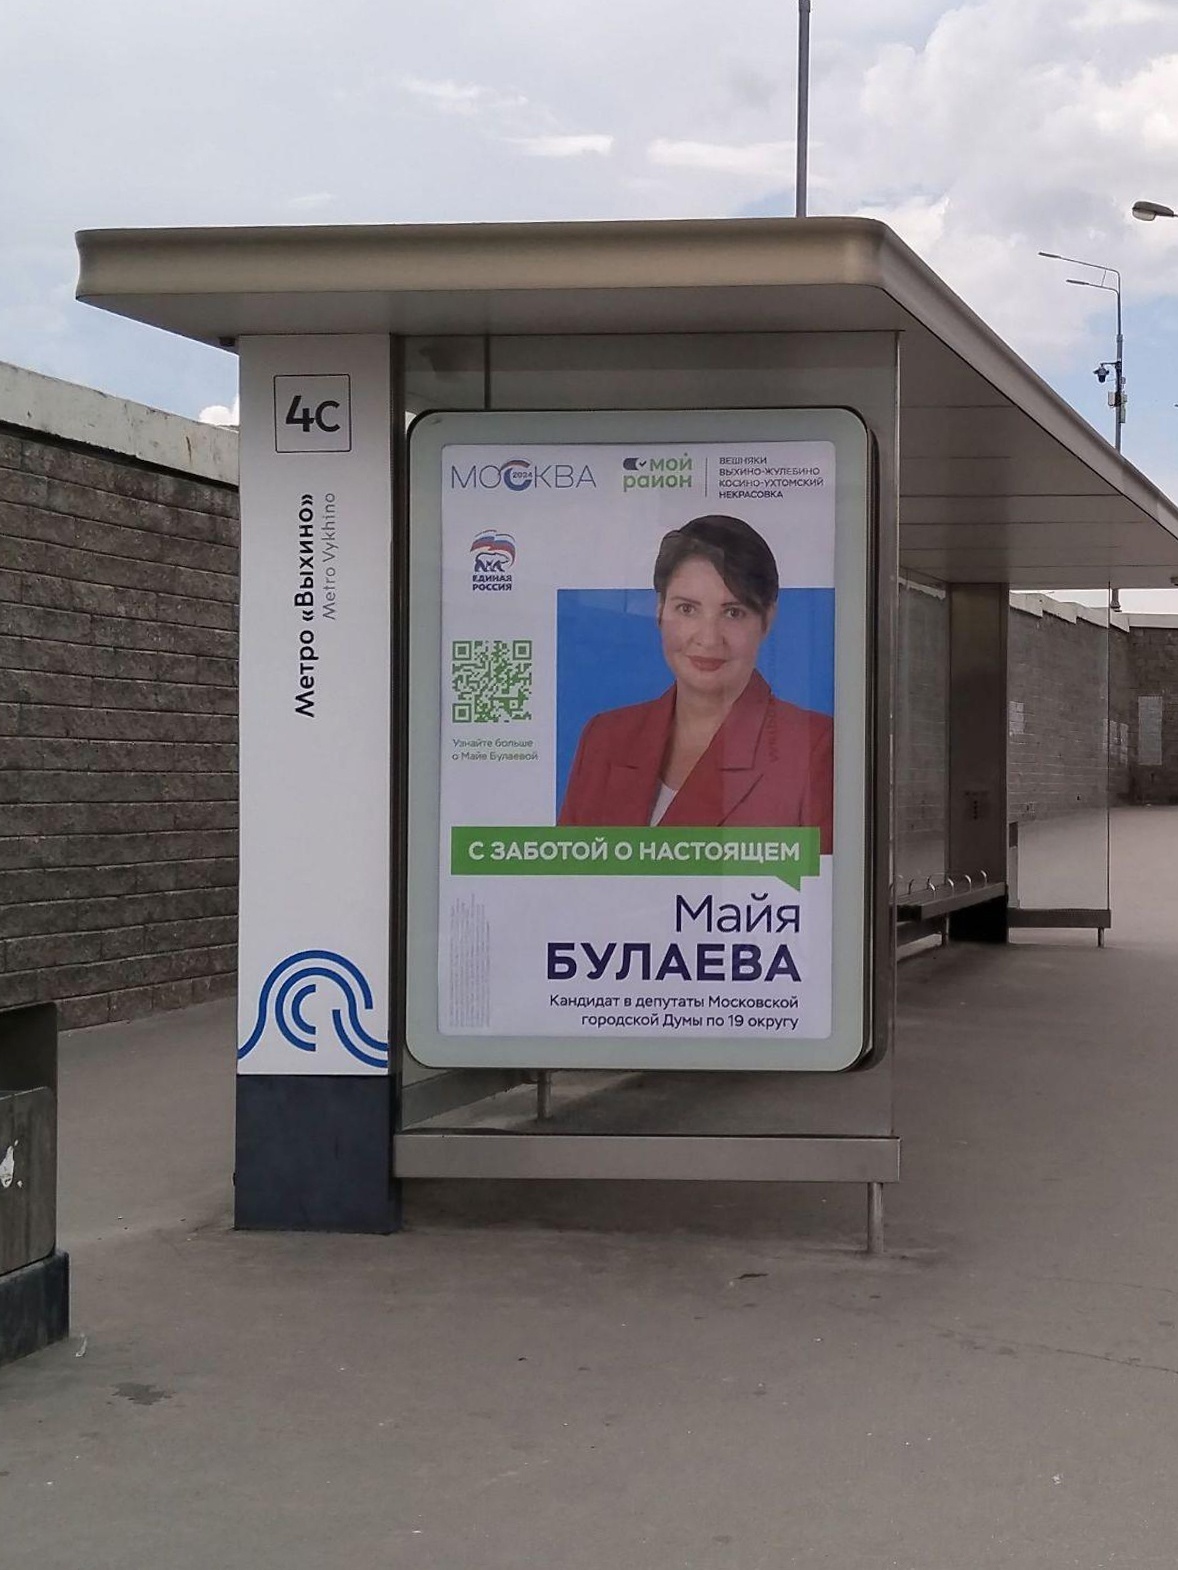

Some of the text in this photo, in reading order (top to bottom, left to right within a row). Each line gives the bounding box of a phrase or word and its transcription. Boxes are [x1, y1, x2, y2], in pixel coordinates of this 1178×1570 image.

[285, 395, 341, 433] 4C
[650, 452, 692, 471] мой
[719, 456, 767, 465] ВЕШНЯКИ
[451, 459, 597, 492] МОСКВА
[512, 471, 534, 479] 2024
[719, 467, 820, 476] ВЫХИНО-ЖУЛЕБИНО
[719, 477, 824, 487] КОСИНО-УХТОМСКИЙ
[719, 490, 783, 499] НЕКРАСОВКА
[321, 491, 337, 621] Metro Vykhino
[472, 574, 513, 583] ЕДИНАЯ
[472, 583, 513, 591] РОССИЯ
[294, 629, 319, 718] Метро
[453, 738, 534, 748] Узнайте больше
[461, 751, 487, 760] Майе
[489, 751, 539, 762] Булаевой
[467, 837, 801, 864] С ЗАБОТОЙ О НАСТОЯЩЕМ
[675, 892, 801, 933] Майя
[546, 942, 802, 982] БУЛАЕВА
[550, 994, 799, 1011] Кандидат в депутаты Московской
[581, 1014, 799, 1031] городской Думы по 19 округу
